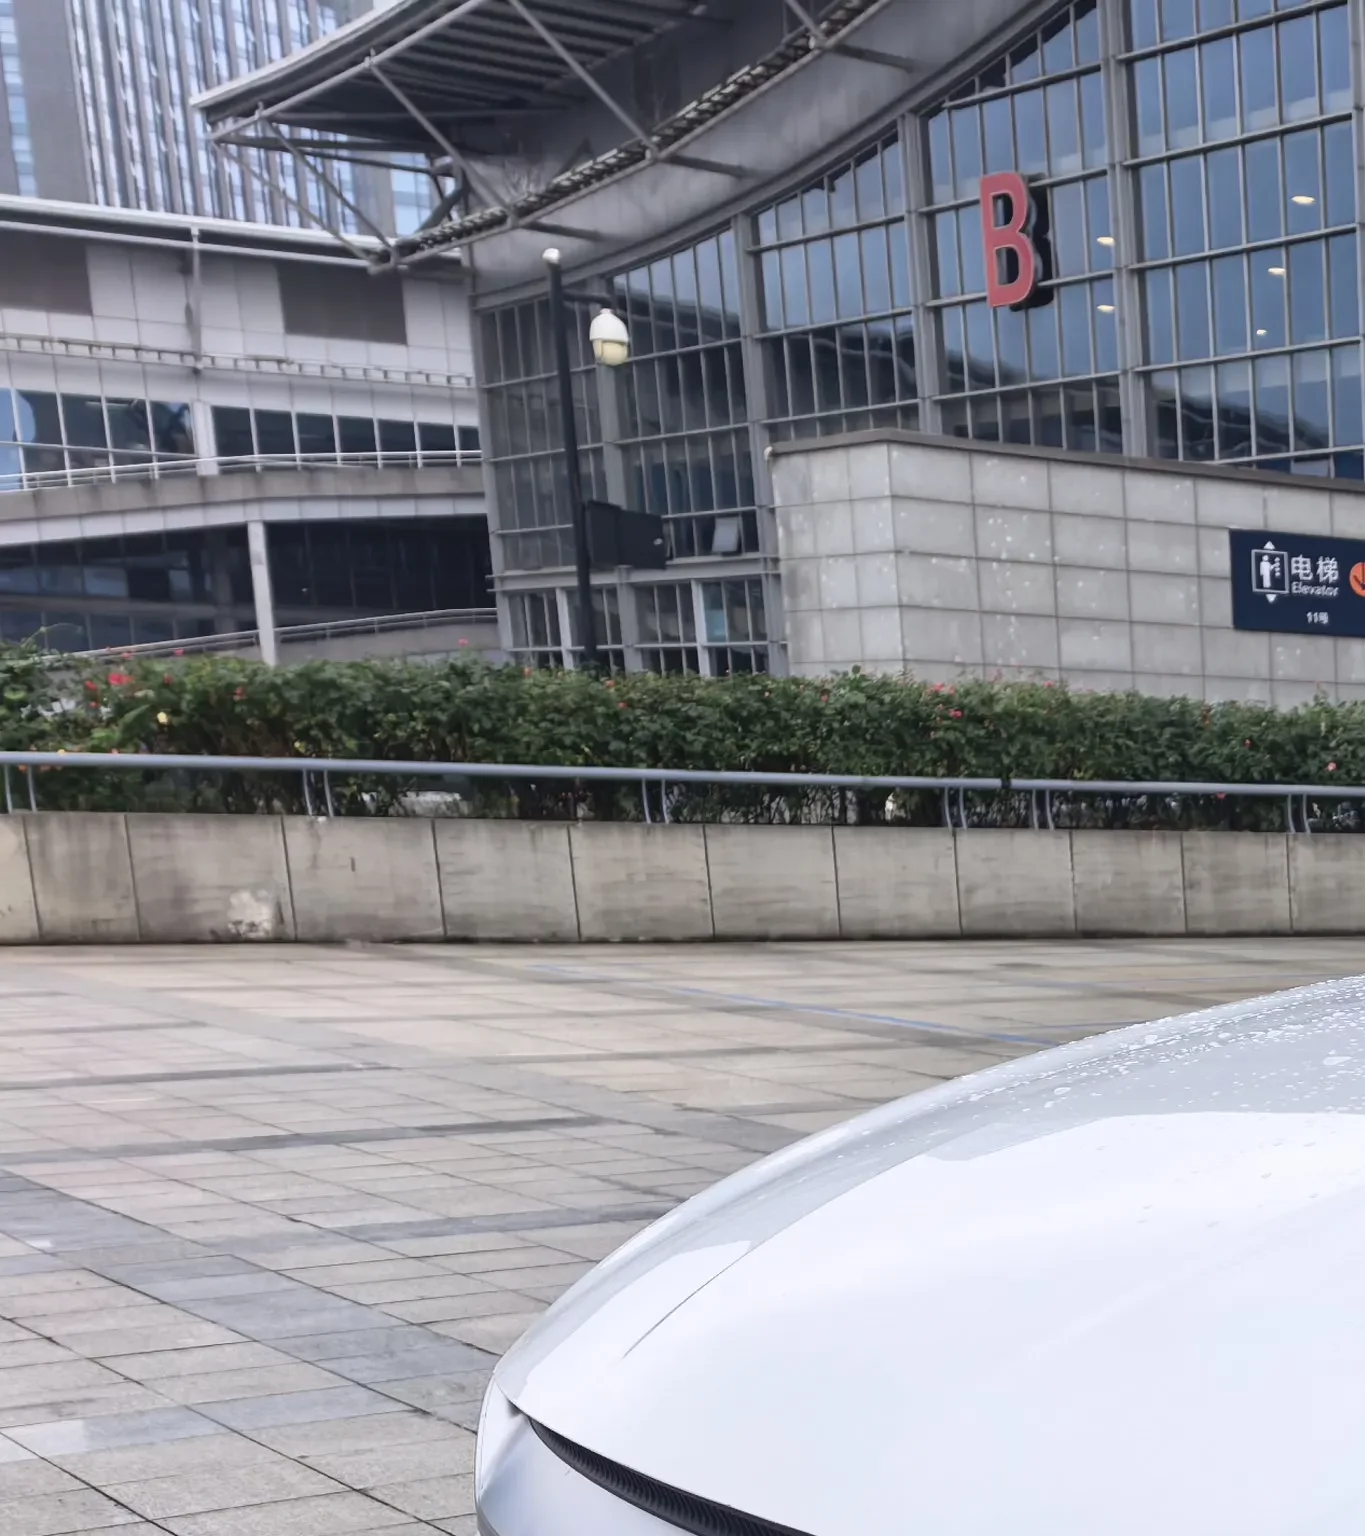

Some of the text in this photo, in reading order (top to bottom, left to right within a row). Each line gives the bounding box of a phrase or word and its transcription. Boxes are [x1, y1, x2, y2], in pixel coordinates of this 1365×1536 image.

[979, 172, 1035, 308] B
[1290, 554, 1340, 583] 电梯
[1291, 581, 1340, 597] Elevator
[1306, 611, 1329, 625] 11号
